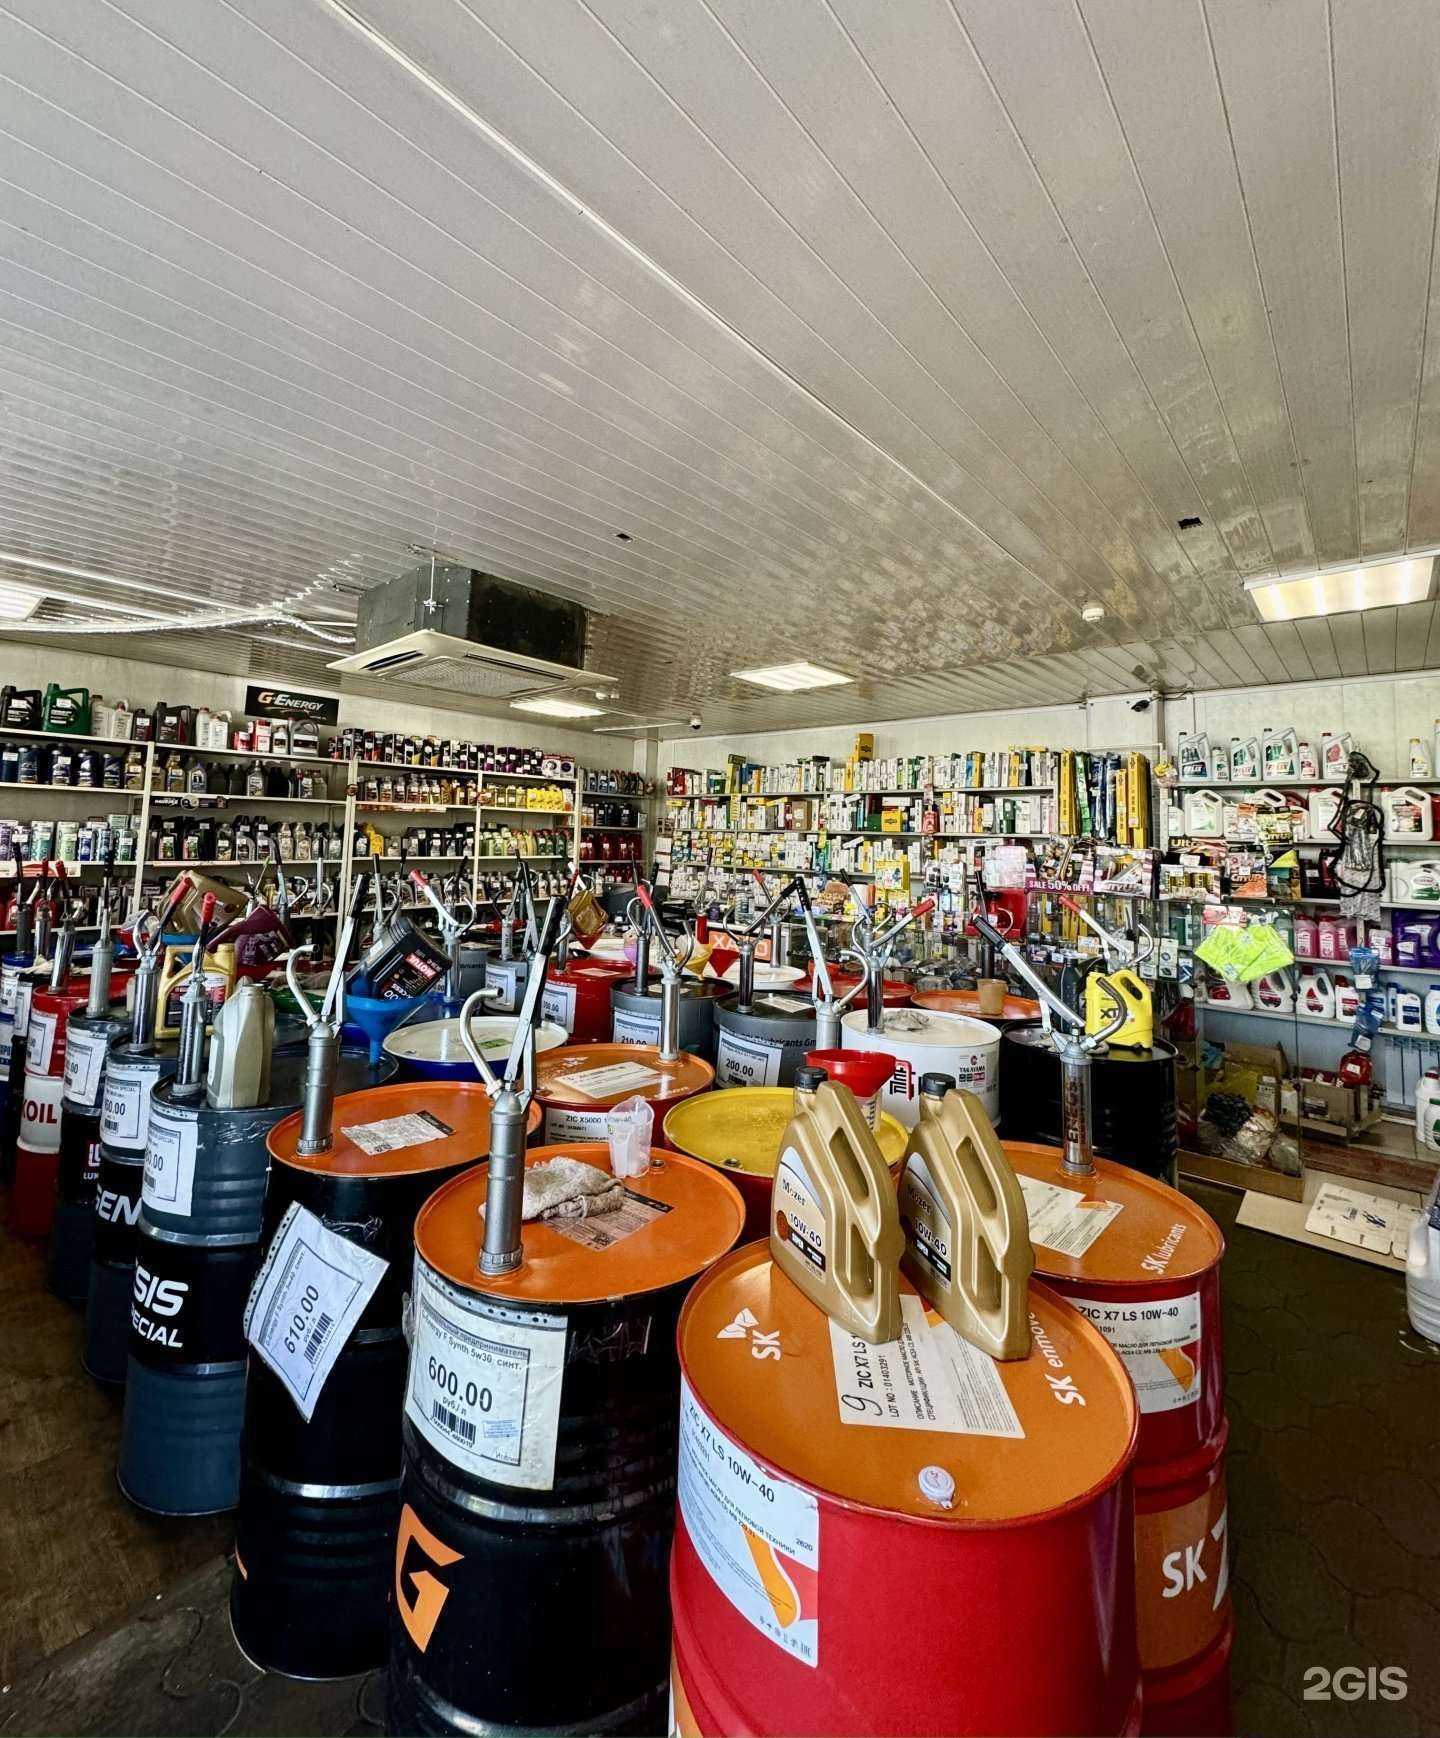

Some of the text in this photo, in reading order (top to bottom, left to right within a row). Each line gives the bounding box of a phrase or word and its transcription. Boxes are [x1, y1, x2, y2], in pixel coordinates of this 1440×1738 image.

[1029, 879, 1090, 892] SALE 50% OFF!
[726, 1058, 754, 1077] 200.00
[22, 1099, 57, 1124] OIL
[790, 1213, 822, 1248] 10W-40
[915, 1217, 947, 1256] 10W-40
[1141, 1223, 1187, 1275] SK lubricants
[285, 1285, 319, 1354] 610.00
[1079, 1306, 1179, 1321] ZIC X7 LS 10W-40
[448, 1336, 469, 1355] Synth
[470, 1349, 493, 1364] 5w30
[751, 1329, 781, 1361] SK
[852, 1340, 867, 1354] LS
[855, 1355, 870, 1368] X7
[428, 1355, 493, 1412] 600.00
[856, 1370, 873, 1389] ZIC
[1044, 1373, 1086, 1407] SK
[886, 1392, 896, 1402] NO
[888, 1404, 900, 1418] LOT
[712, 1438, 726, 1461] LS
[728, 1456, 776, 1503] 10W-40
[1161, 1537, 1207, 1598] SK
